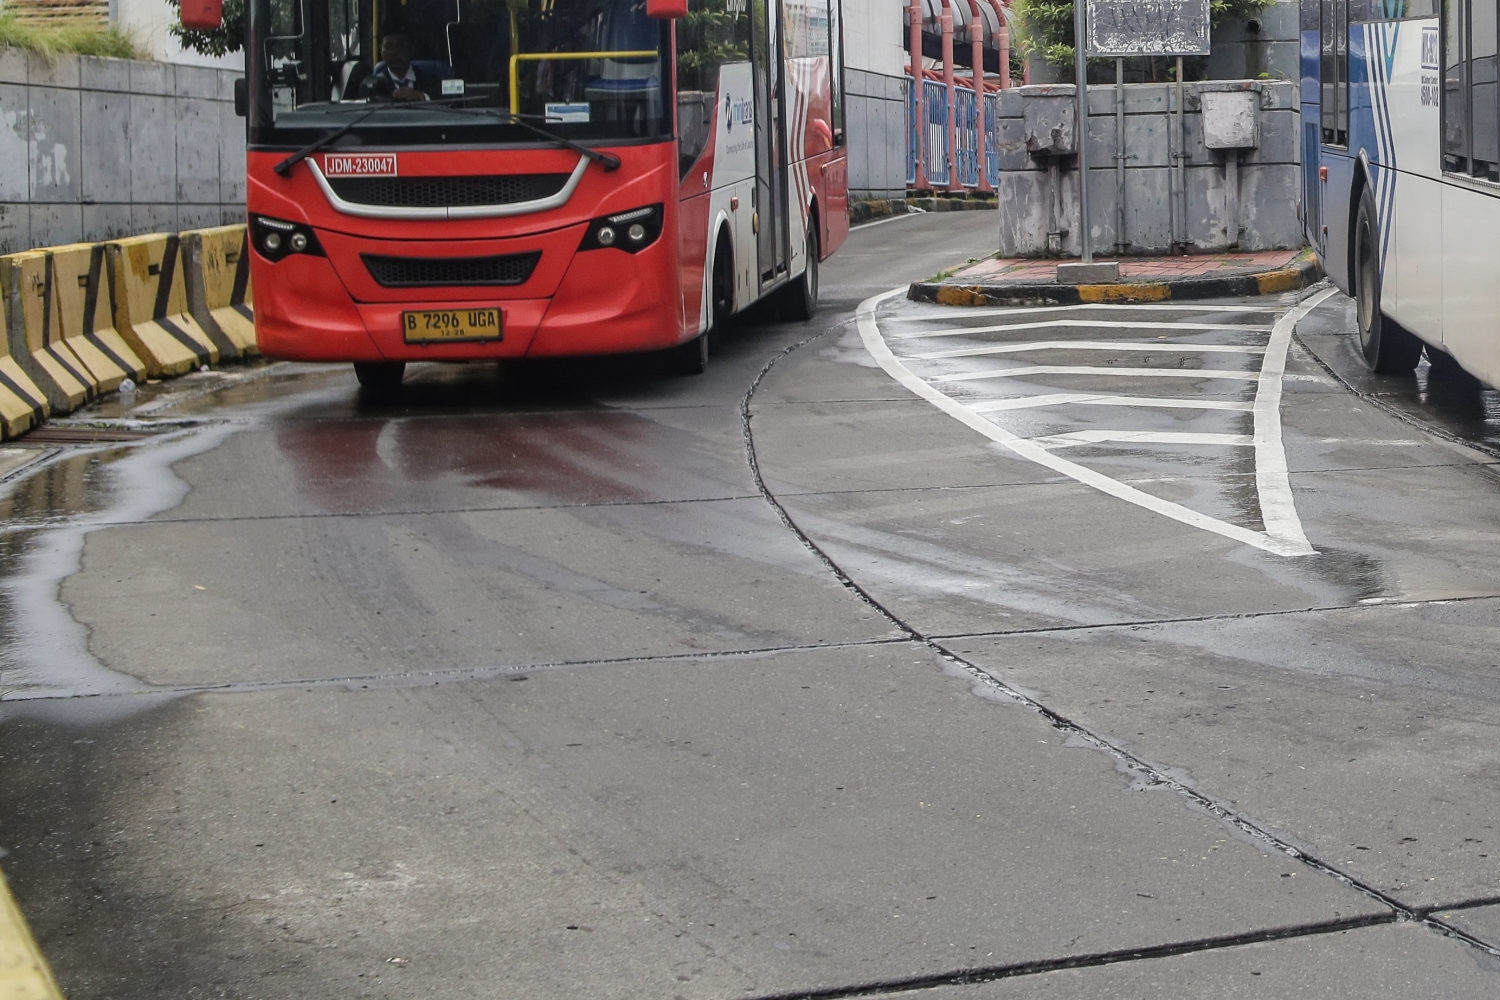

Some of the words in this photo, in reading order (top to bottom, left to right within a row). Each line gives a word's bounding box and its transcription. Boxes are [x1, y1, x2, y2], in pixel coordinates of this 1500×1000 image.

[328, 157, 394, 174] JDM-230047
[407, 314, 417, 330] B
[423, 312, 460, 330] 7296
[467, 311, 497, 328] UGA
